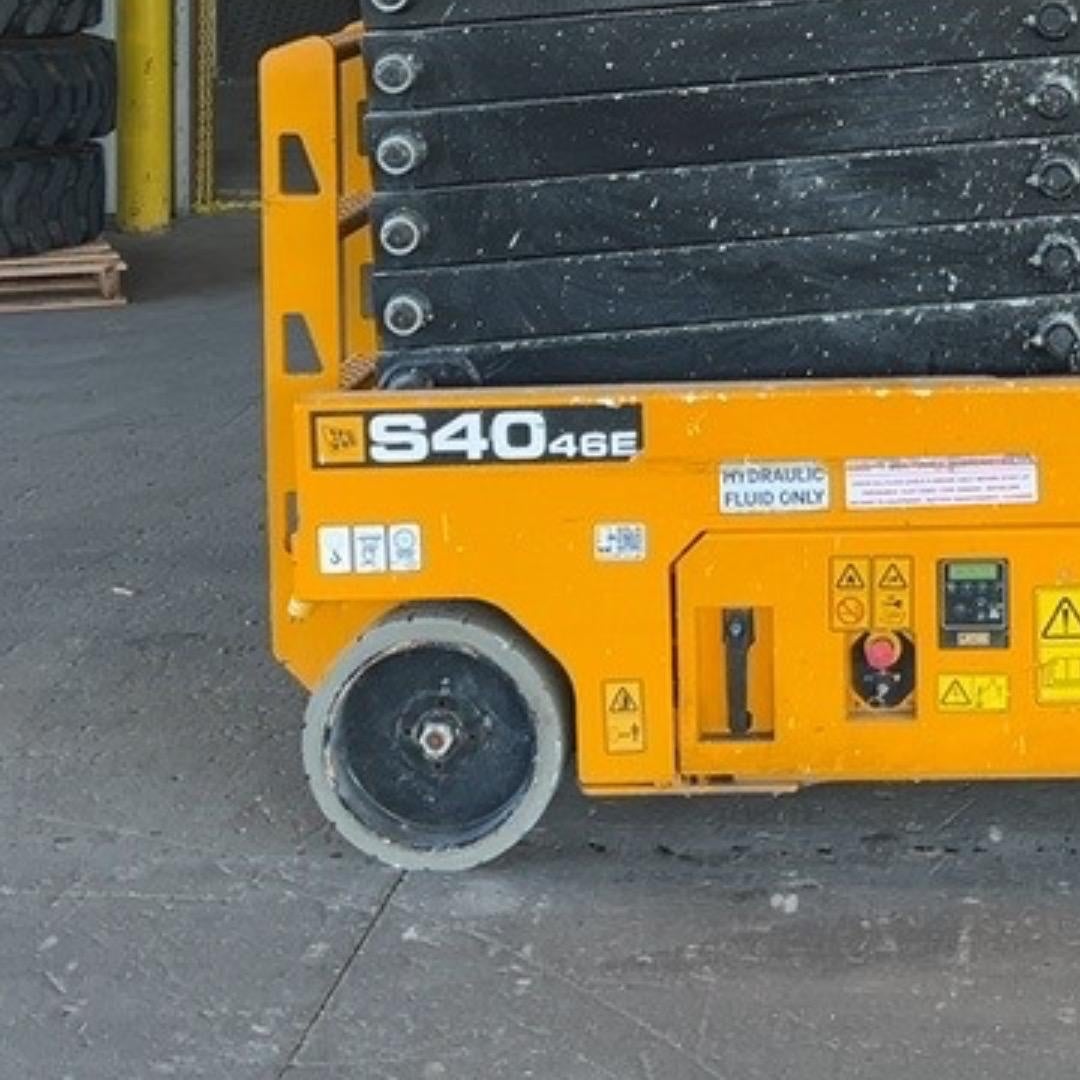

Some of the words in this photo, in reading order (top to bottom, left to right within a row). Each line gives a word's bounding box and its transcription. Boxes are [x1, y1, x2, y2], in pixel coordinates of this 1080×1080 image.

[723, 467, 825, 484] HYDRAULIC
[725, 491, 776, 507] FLUID
[779, 489, 824, 505] ONLY
